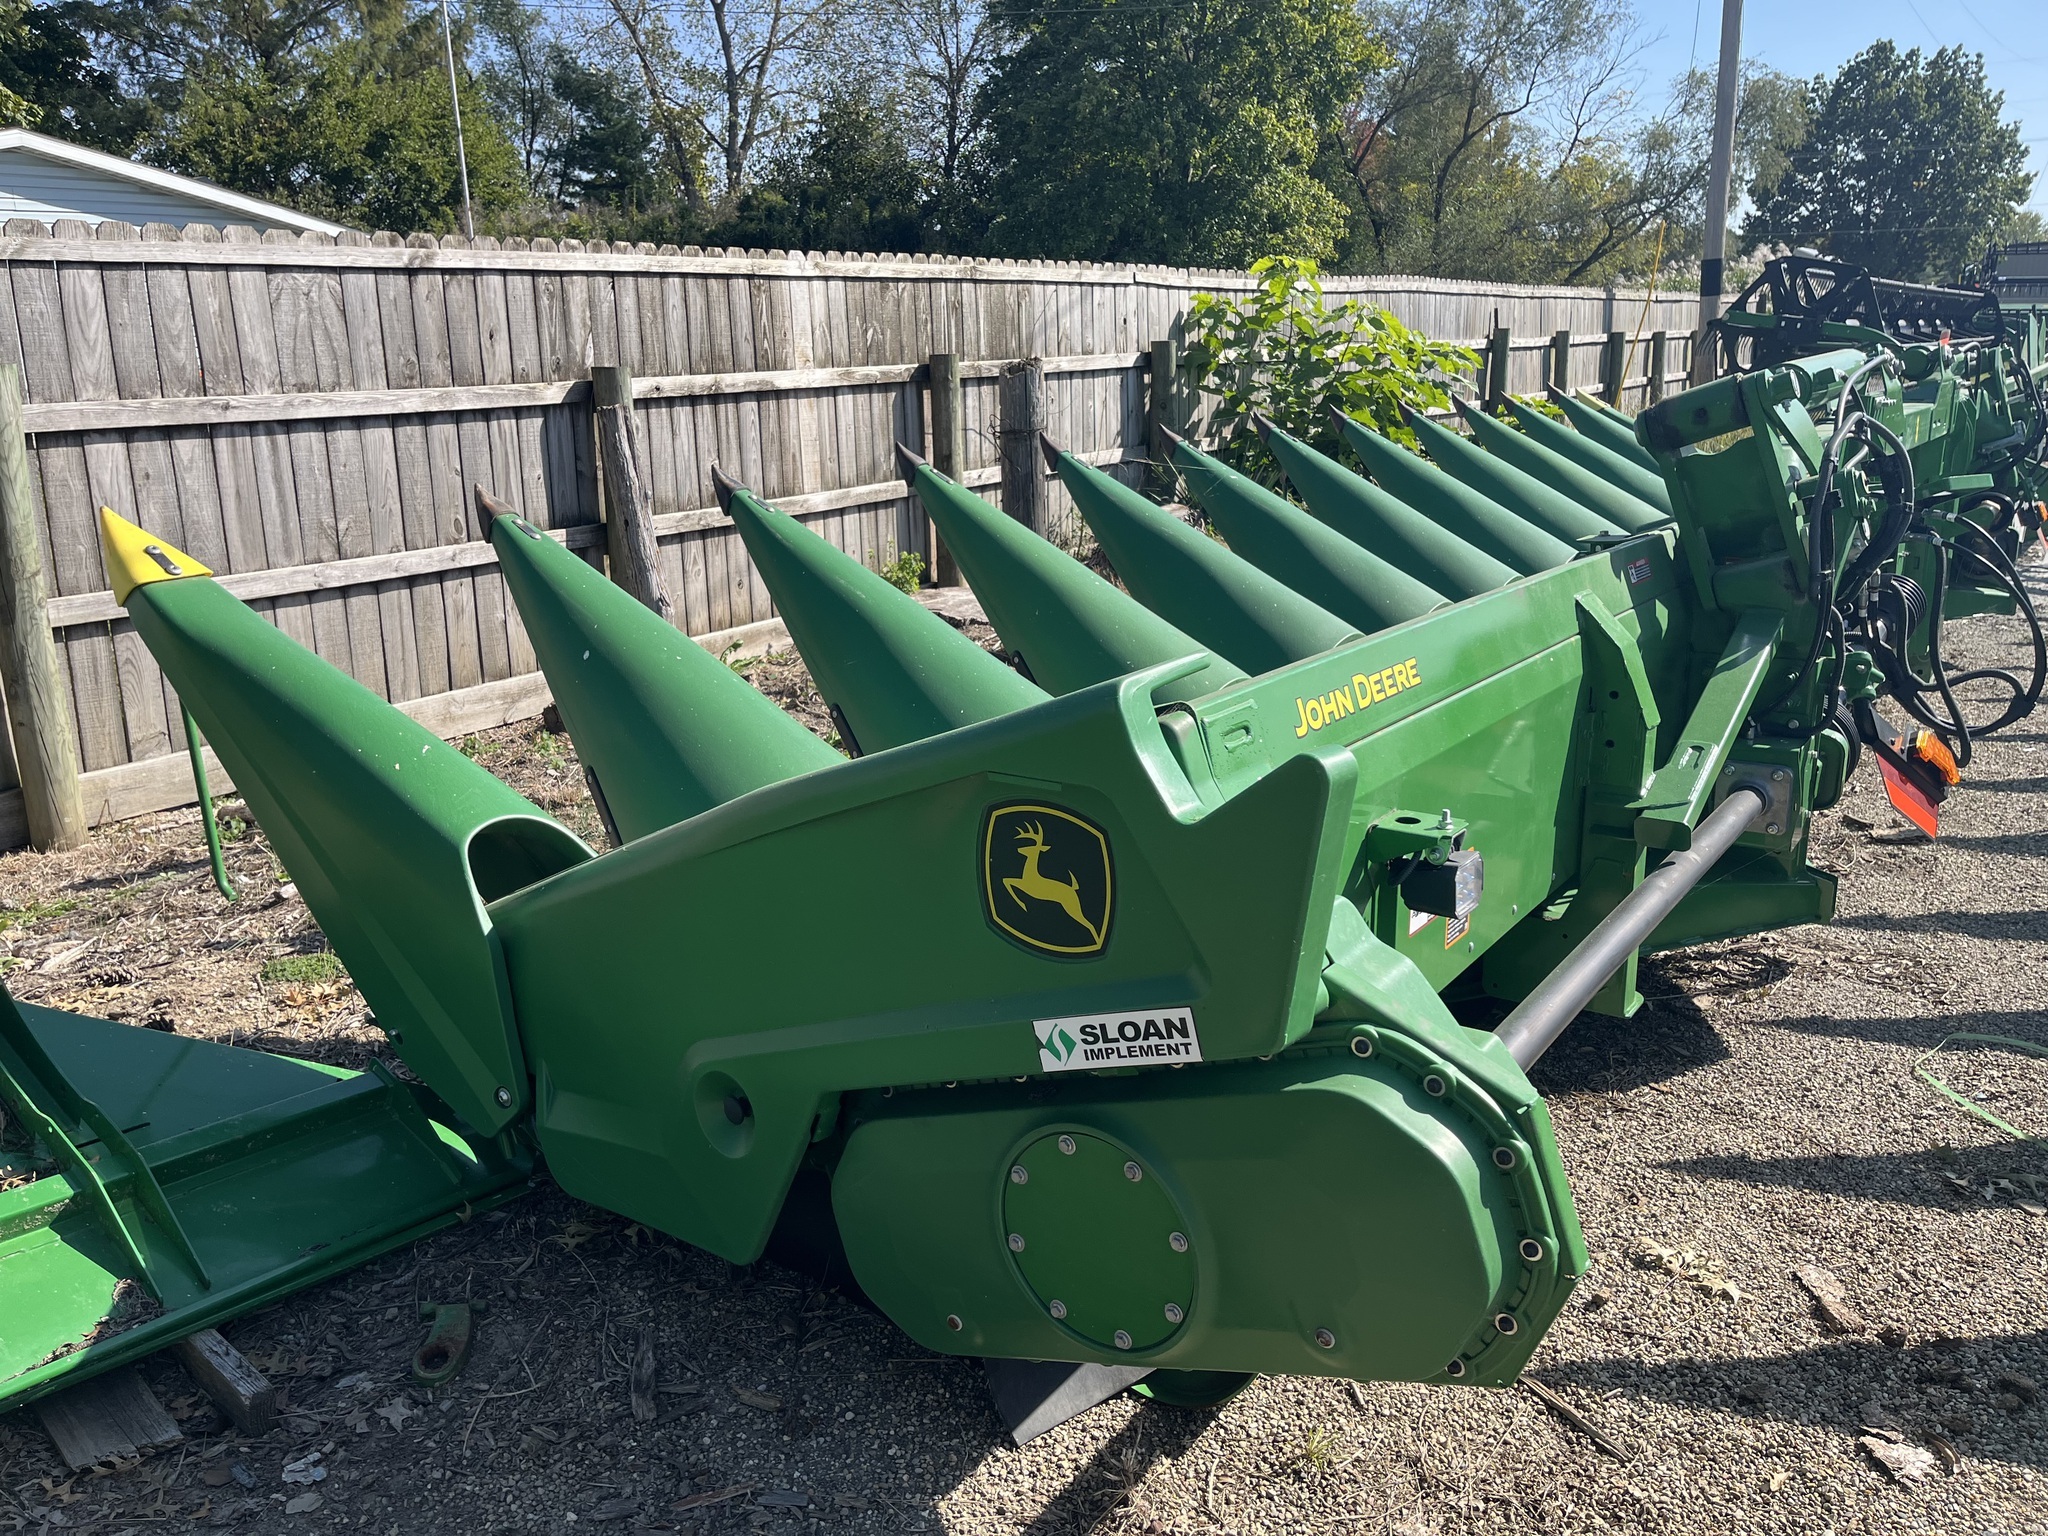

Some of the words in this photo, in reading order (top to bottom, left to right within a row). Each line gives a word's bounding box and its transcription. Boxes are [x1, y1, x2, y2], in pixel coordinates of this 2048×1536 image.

[1294, 684, 1356, 739] JOHN
[1351, 656, 1422, 712] DEERE
[1079, 1017, 1190, 1046] SLOAN
[1083, 1042, 1192, 1062] IMPLEMENT
